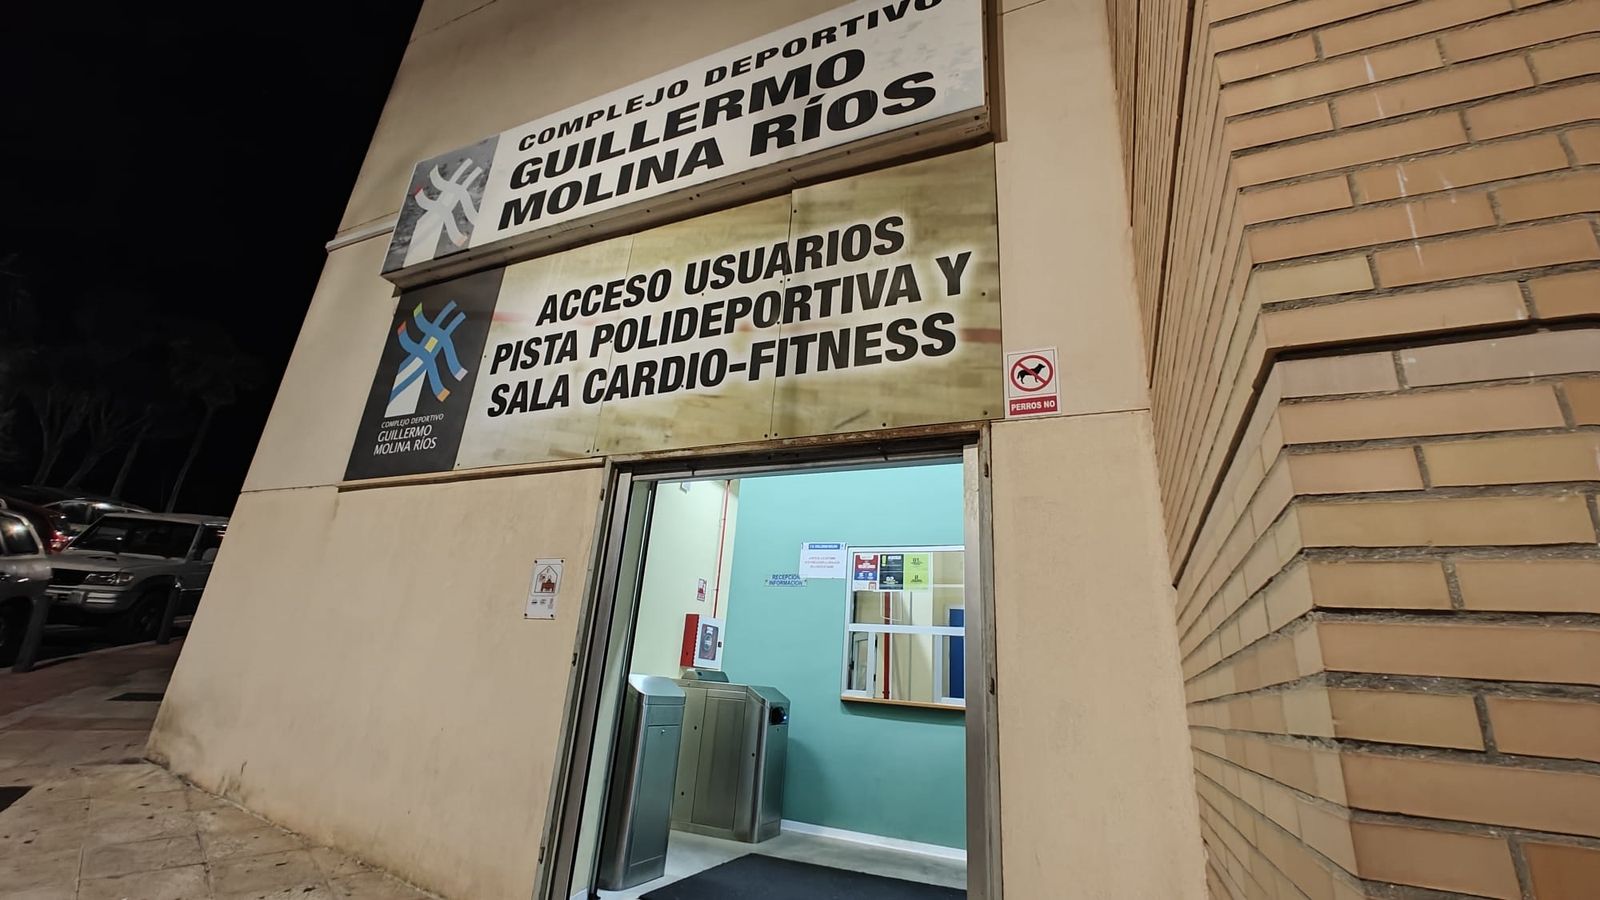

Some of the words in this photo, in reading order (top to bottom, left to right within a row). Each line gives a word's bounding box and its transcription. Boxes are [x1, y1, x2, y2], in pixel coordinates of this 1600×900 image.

[497, 137, 724, 232] MOLINA
[750, 71, 936, 157] RÍOS
[509, 49, 866, 190] GUILLERMO
[518, 79, 689, 152] COMPLEJO
[489, 330, 578, 375] PISTA
[589, 263, 922, 358] POLIDEPORTIVA
[935, 251, 972, 297] Y
[535, 268, 672, 327] ACCESO
[684, 216, 905, 295] USUARIOS
[487, 374, 570, 417] SALA
[582, 312, 957, 404] CARDIO-FITNESS
[1011, 401, 1042, 411] PERROS
[1043, 400, 1056, 408] NO
[373, 441, 411, 456] MOLINA
[413, 435, 437, 451] RÍOS
[377, 424, 433, 442] GUILLERMO
[381, 419, 410, 428] COMPLEJO
[410, 413, 444, 424] DEPORTIVO
